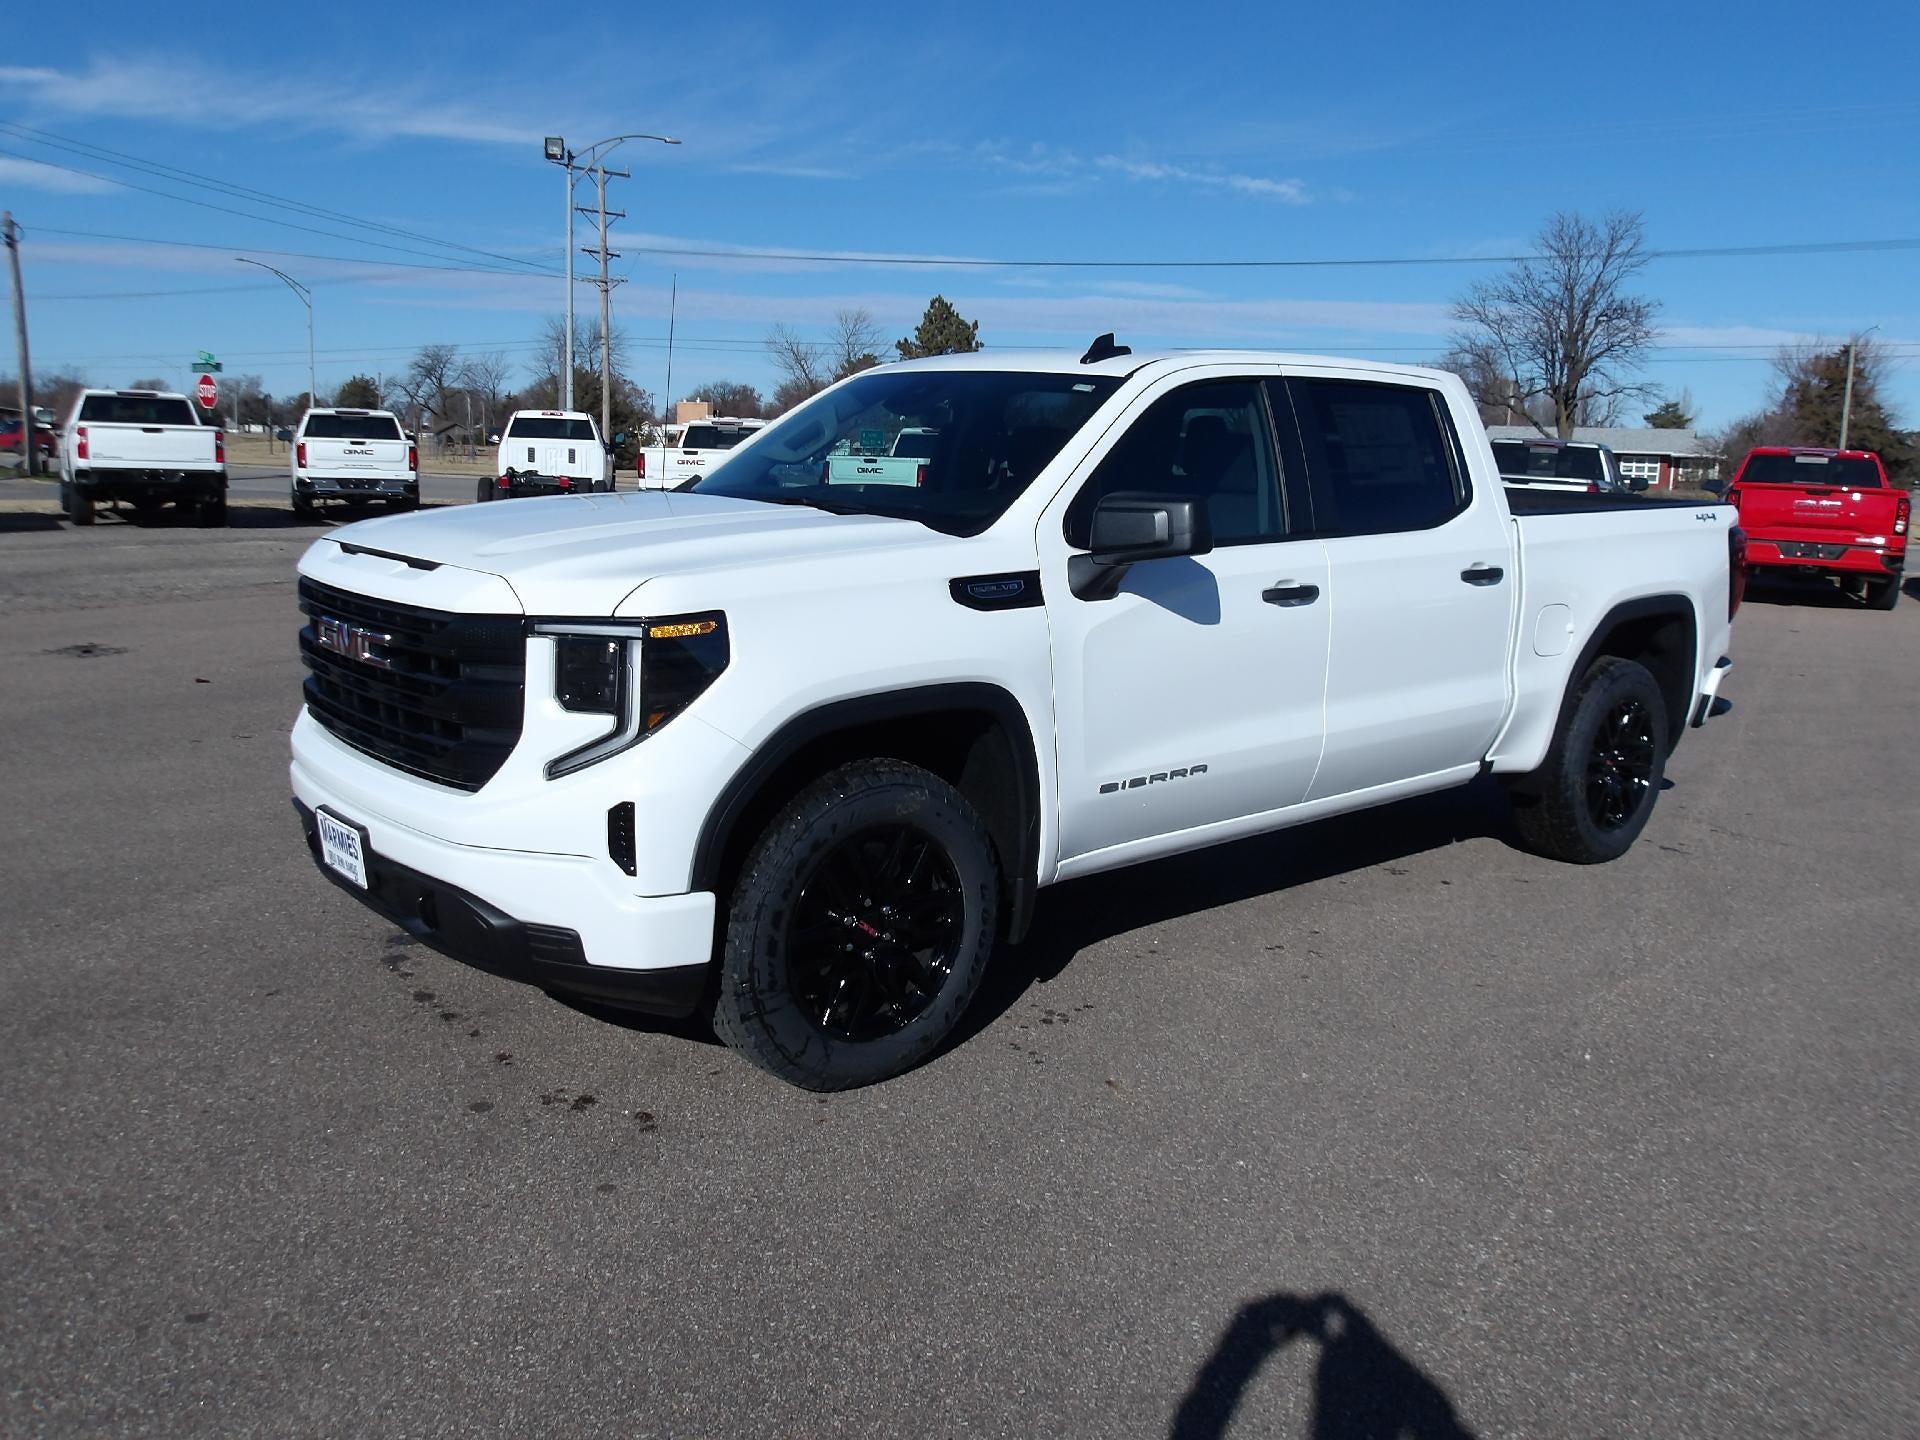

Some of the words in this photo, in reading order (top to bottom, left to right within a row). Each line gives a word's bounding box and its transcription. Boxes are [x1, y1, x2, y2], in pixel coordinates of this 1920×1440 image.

[199, 384, 216, 398] STOP
[318, 615, 392, 670] GMC
[1099, 764, 1208, 794] SIERRA
